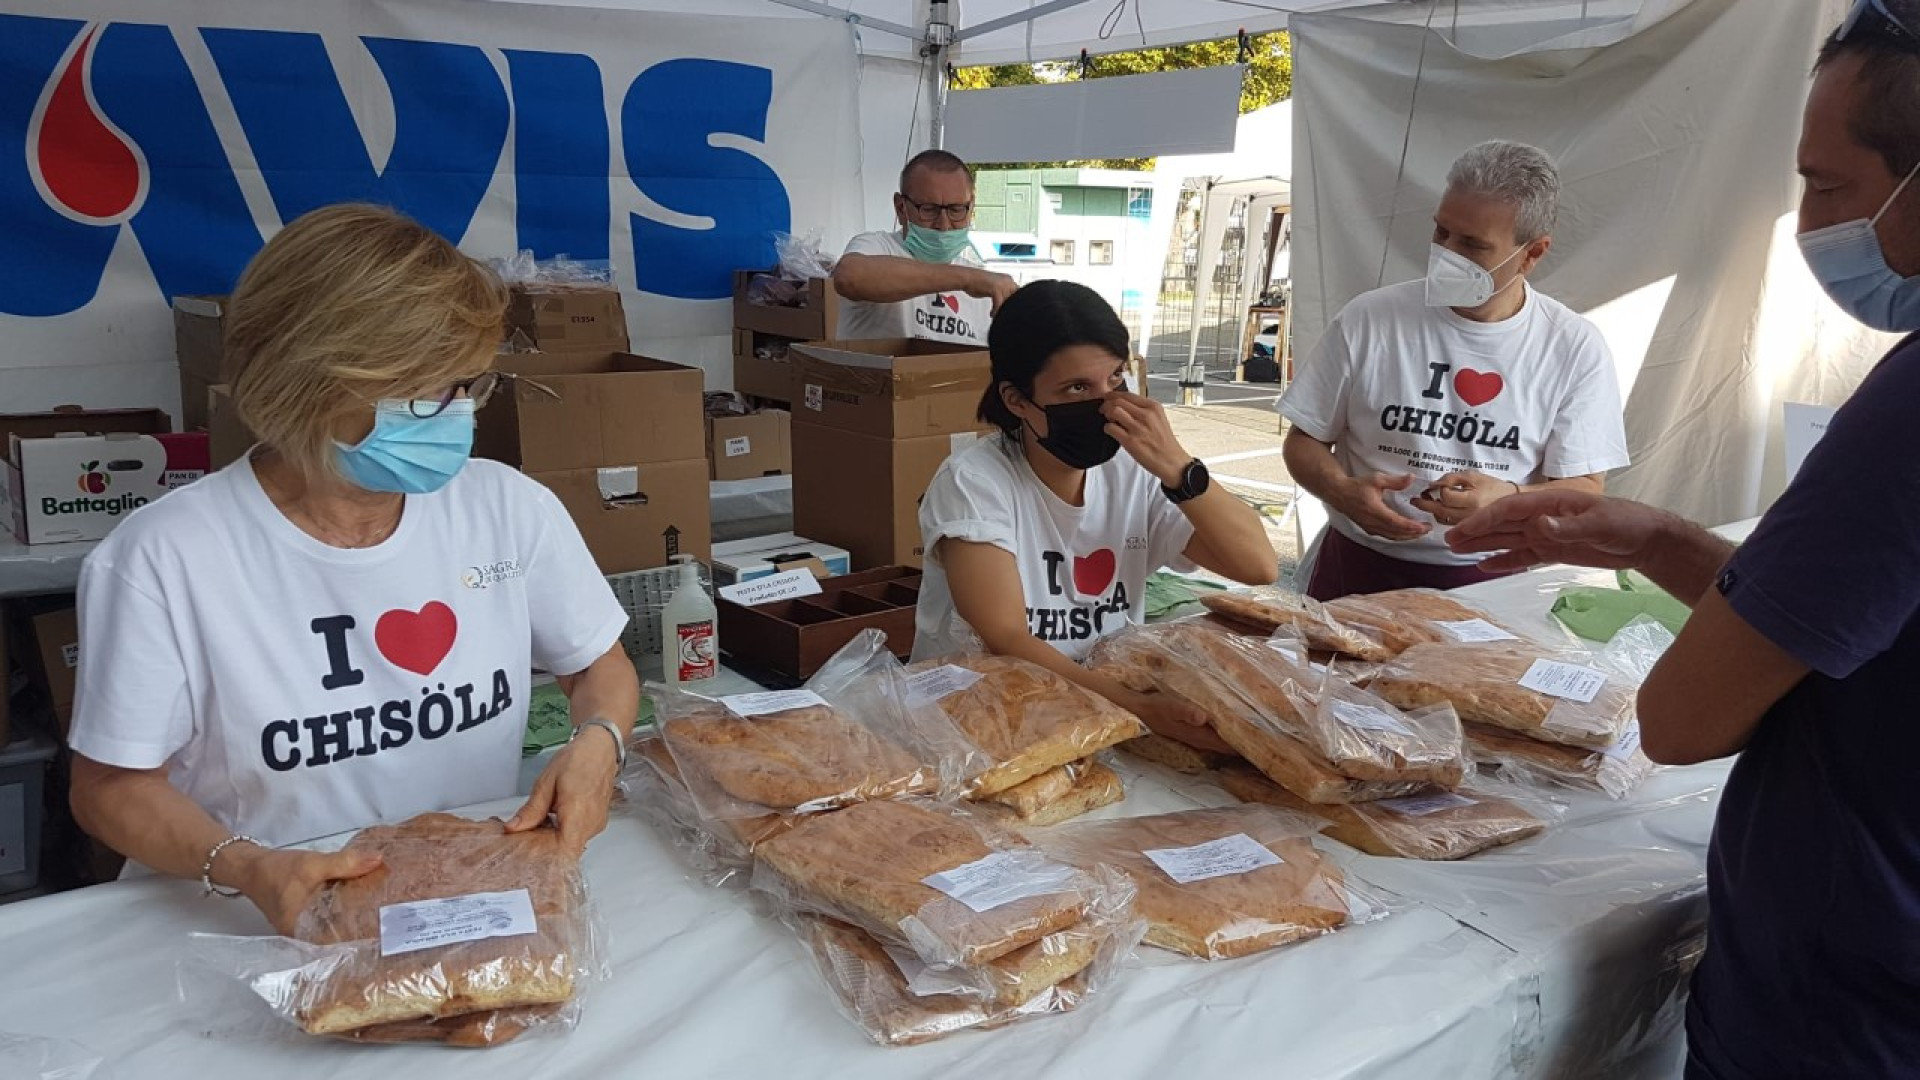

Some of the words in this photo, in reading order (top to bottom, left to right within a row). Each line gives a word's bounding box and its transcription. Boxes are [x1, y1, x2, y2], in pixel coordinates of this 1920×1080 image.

[0, 14, 793, 317] AVIS
[1421, 361, 1451, 400] I
[1380, 404, 1520, 450] CHISÖLA
[169, 472, 187, 480] PAN
[41, 491, 148, 516] Battaglio
[1042, 550, 1065, 595] I
[310, 614, 365, 691] I
[260, 668, 513, 772] CHISÖLA
